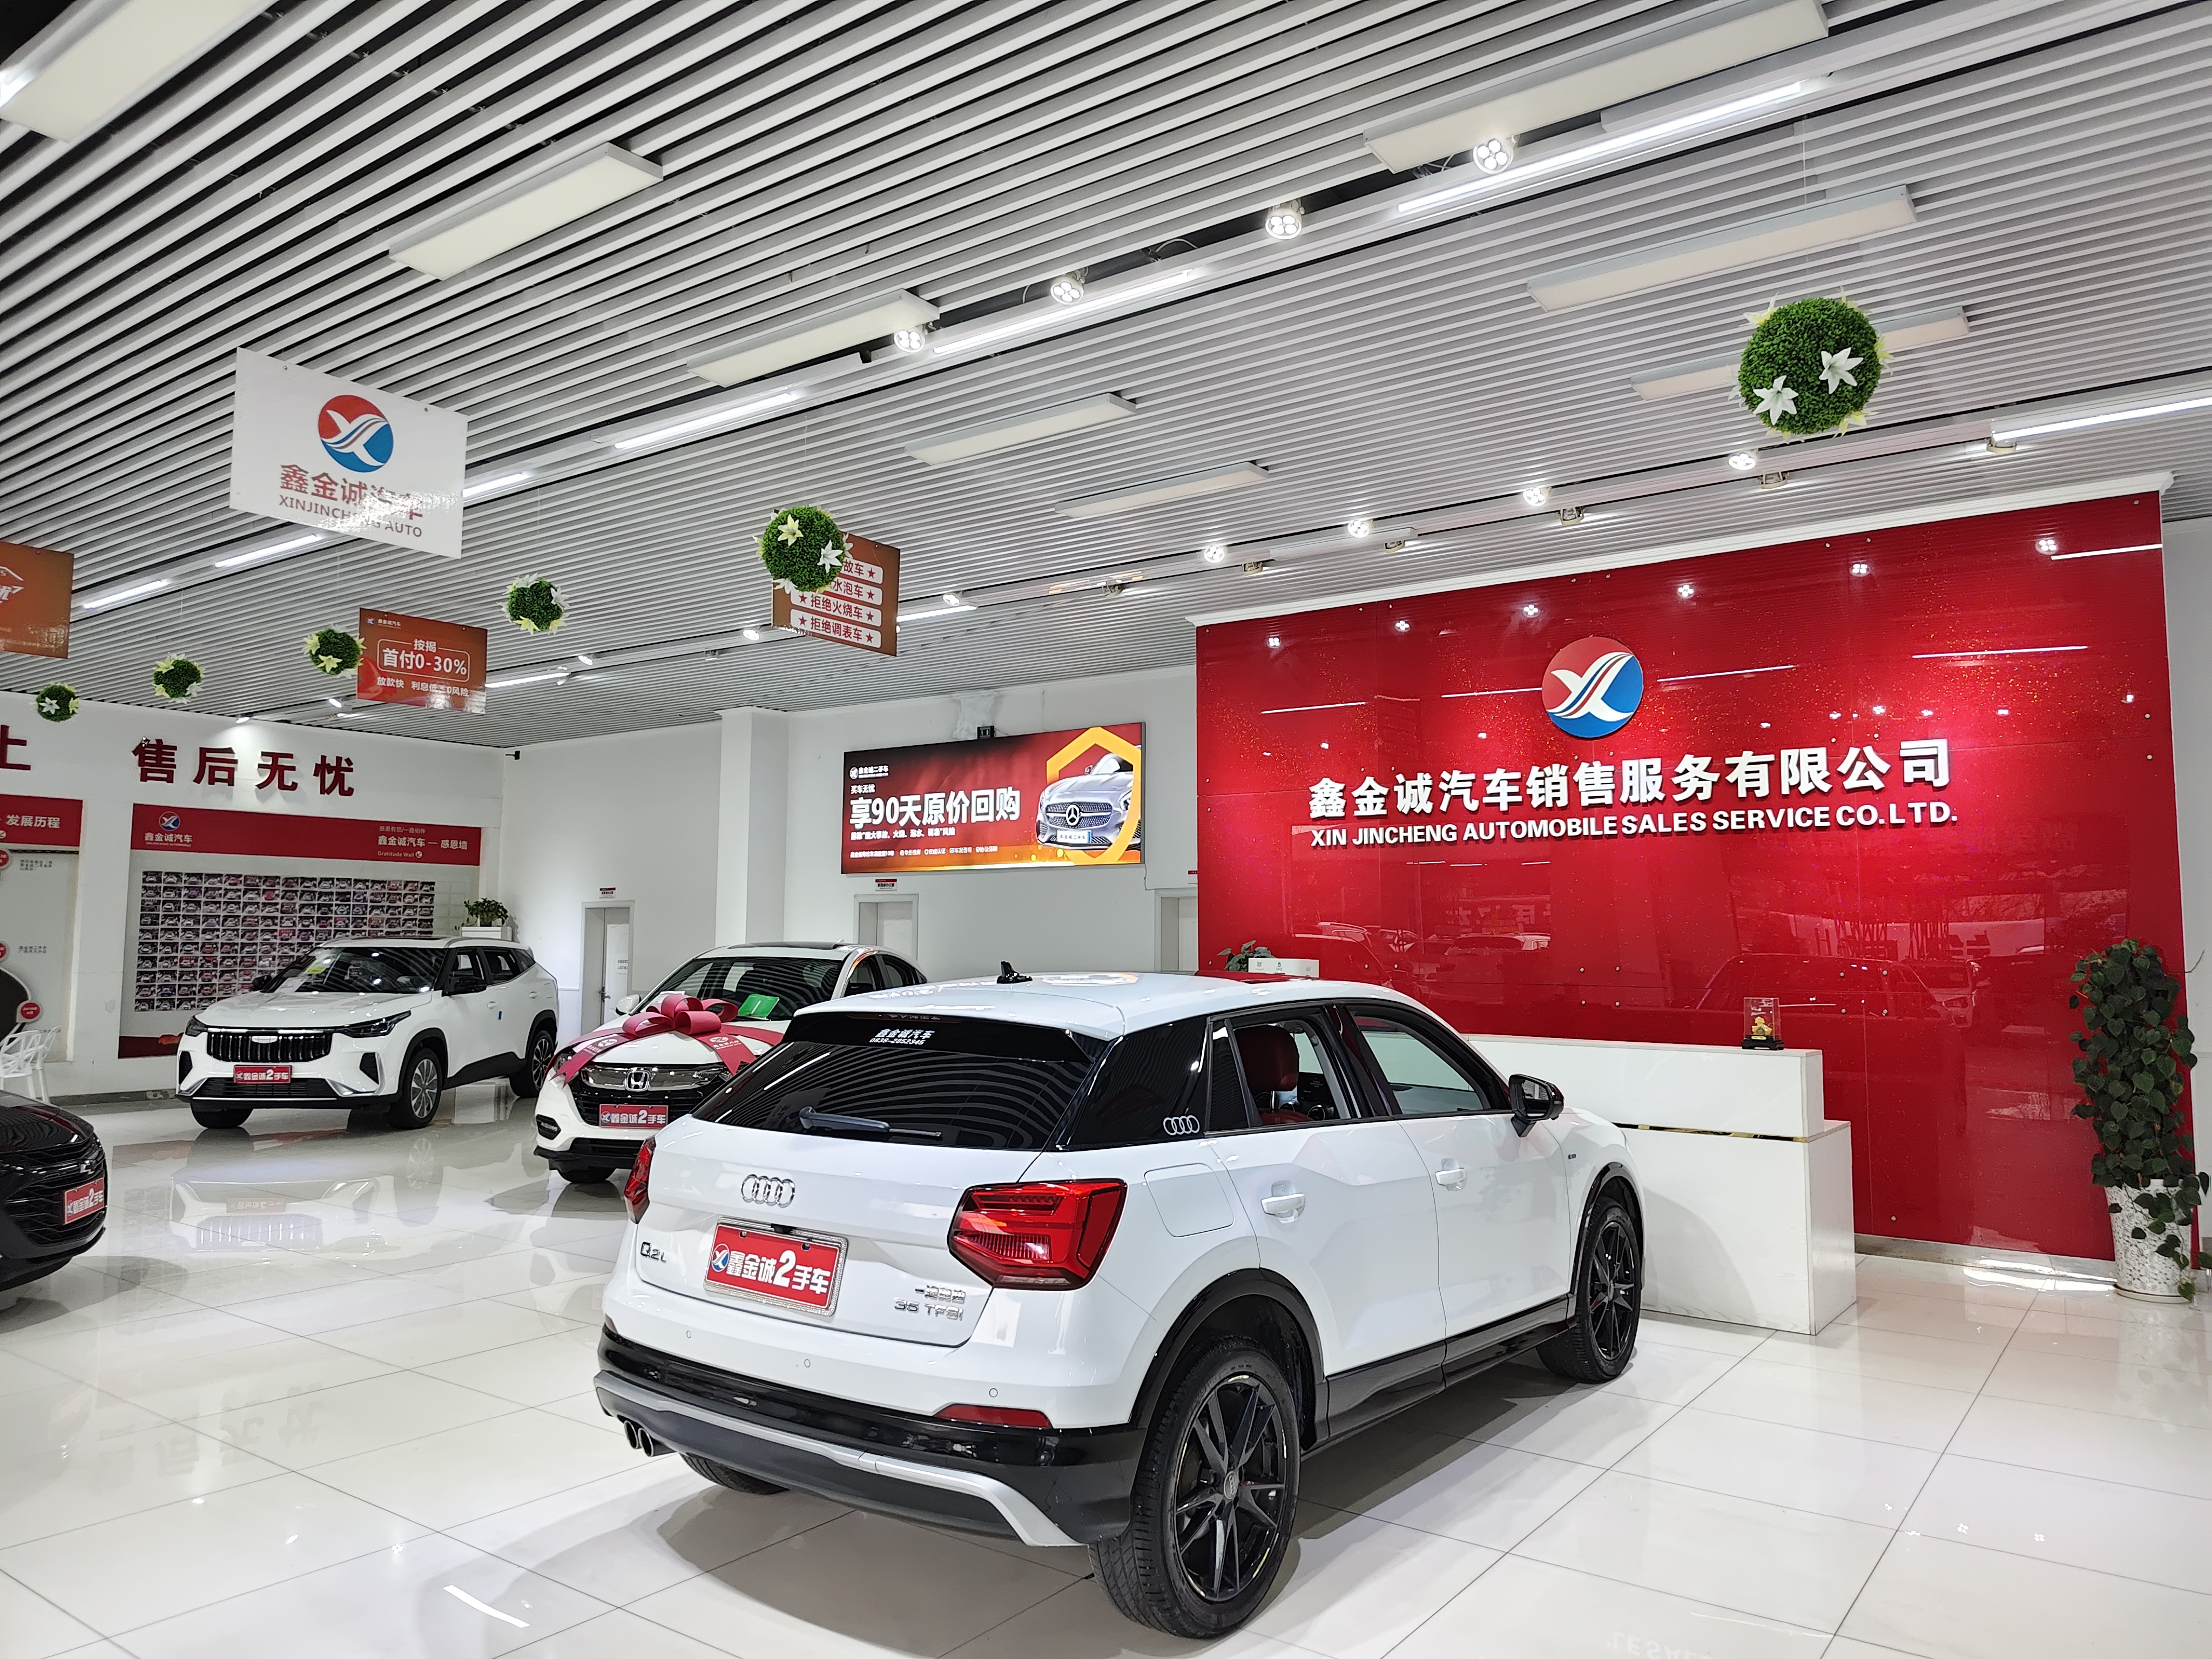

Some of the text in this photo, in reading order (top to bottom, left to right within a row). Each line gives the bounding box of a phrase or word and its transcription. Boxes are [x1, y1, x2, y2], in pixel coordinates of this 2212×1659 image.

[385, 521, 422, 537] AUTO
[844, 559, 864, 576] 故车
[833, 579, 864, 598] 水泡车
[811, 596, 863, 619] 拒绝火烧车
[811, 617, 862, 641] 拒绝调表车
[414, 638, 436, 652] 按揭
[382, 648, 467, 675] 首付0-30%
[377, 677, 404, 689] 放款快
[132, 738, 354, 797] 售后无忧
[1309, 738, 1950, 819] 鑫金诚汽车销售服务有限公司
[849, 786, 1021, 829] 享90天原价回购
[6, 814, 60, 828] 发展历程
[1311, 828, 1347, 847] XIN
[1352, 824, 1458, 846] JINCHENG
[1462, 815, 1618, 841] AUTOMOBILE
[1621, 811, 1707, 834] SALES
[1712, 806, 1831, 831] SERVICE
[640, 1242, 667, 1263] Q2L
[726, 1249, 831, 1295] 鑫金诚2手车
[894, 1298, 963, 1321] 35 TFSI
